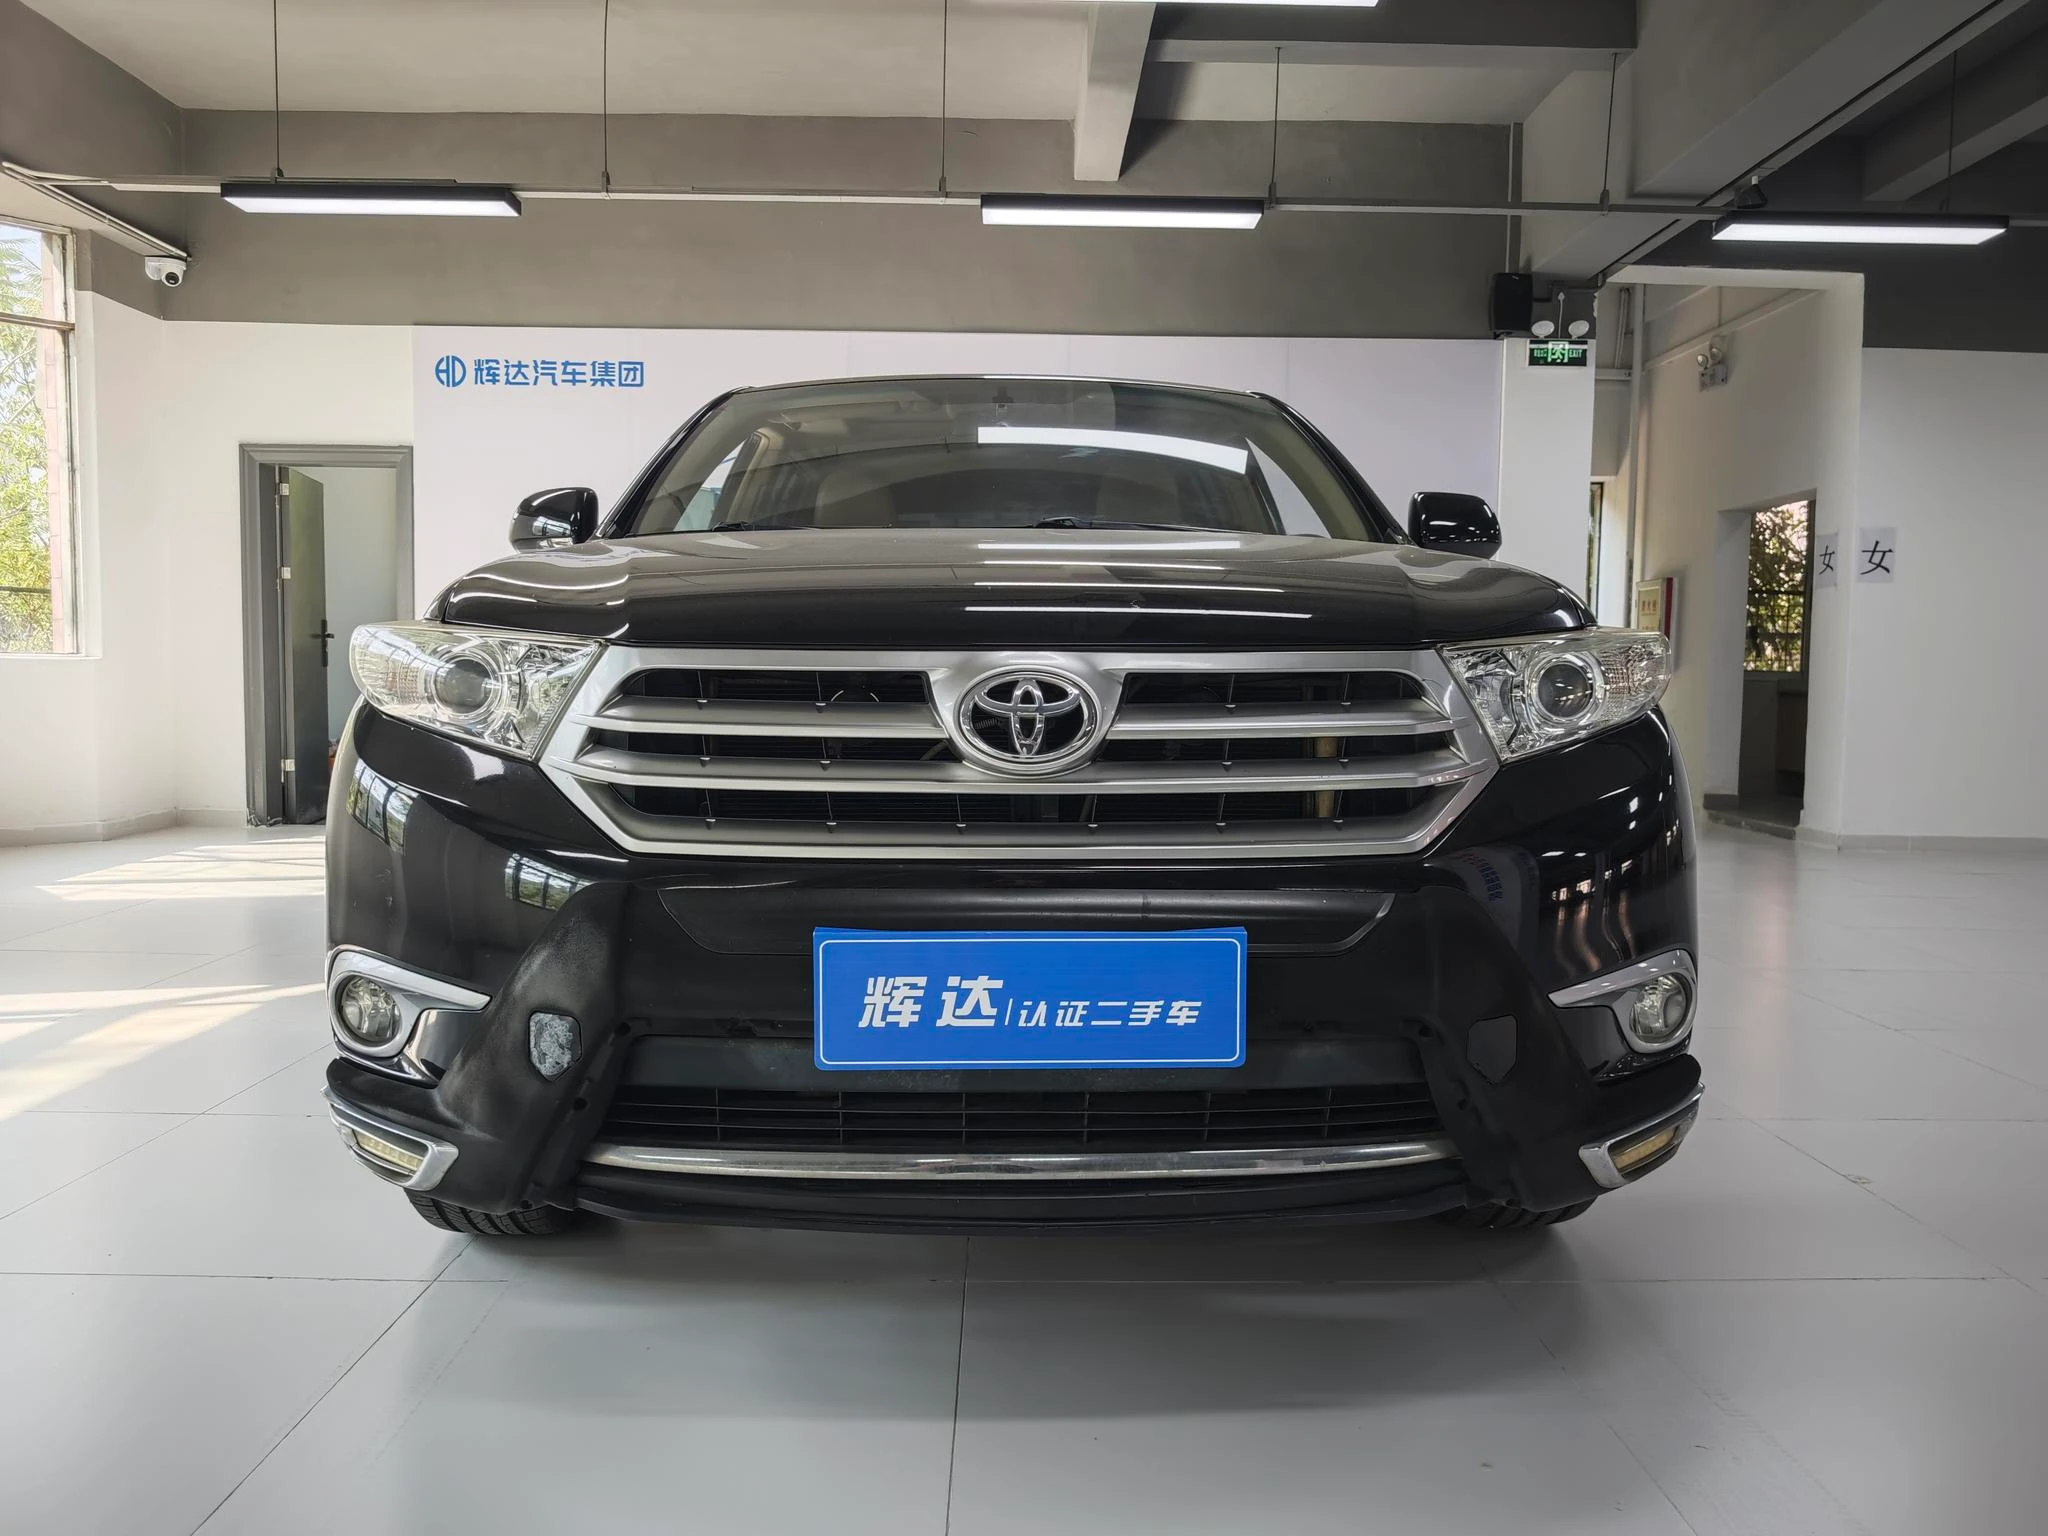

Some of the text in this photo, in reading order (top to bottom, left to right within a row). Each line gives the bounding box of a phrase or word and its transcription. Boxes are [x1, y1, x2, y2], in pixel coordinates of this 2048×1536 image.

[1568, 349, 1583, 358] EXIT
[474, 359, 644, 387] 辉达汽车集团
[1819, 545, 1835, 575] 女
[1860, 540, 1894, 575] 女
[858, 976, 1201, 1028] 辉达 认证二手车
